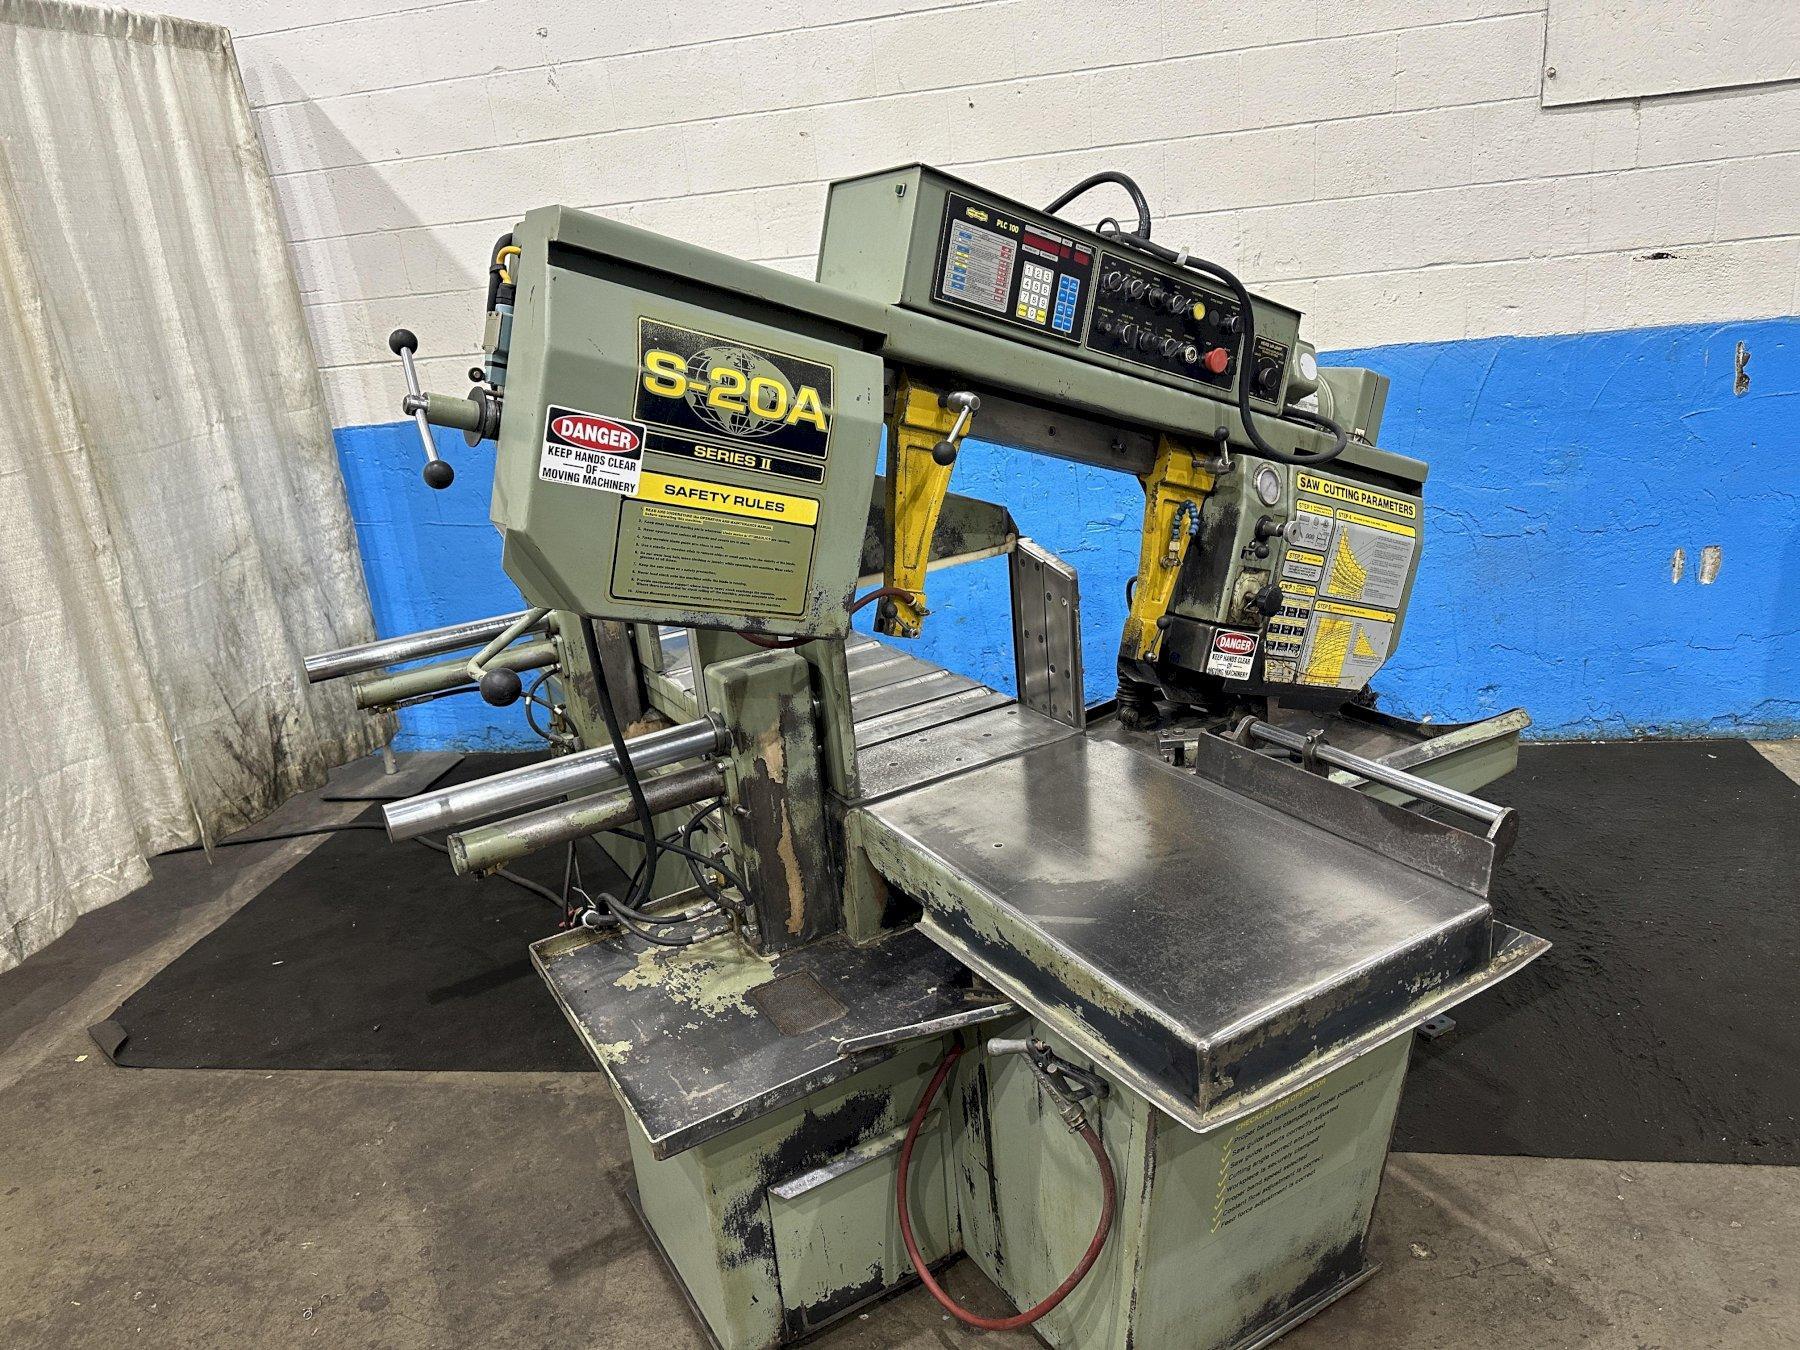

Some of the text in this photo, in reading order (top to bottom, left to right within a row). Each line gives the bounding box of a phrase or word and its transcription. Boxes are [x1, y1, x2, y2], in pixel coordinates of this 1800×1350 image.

[996, 219, 1008, 229] PLC
[1008, 222, 1019, 234] 100
[643, 350, 828, 433] S-20A
[560, 419, 632, 449] DANGER
[548, 445, 636, 471] KEEP HANDS CLEAR
[694, 445, 773, 471] SERIES II
[542, 467, 636, 493] MOVING MACHINERY
[586, 464, 598, 475] OF
[664, 484, 785, 513] SAFETY RULES
[1298, 502, 1310, 510] STEP
[1300, 477, 1414, 516] SAW CUTTING PARAMETERS
[1338, 511, 1349, 519] STEP
[1288, 552, 1300, 560] STEP
[1219, 636, 1252, 652] DANGER
[1223, 654, 1237, 662] HANDS
[1237, 656, 1250, 664] CLEAR
[1233, 1129, 1256, 1144] Proper
[1256, 1119, 1273, 1132] band
[1232, 1146, 1246, 1156] Saw
[1246, 1135, 1265, 1150] guide
[1230, 1157, 1243, 1169] Saw
